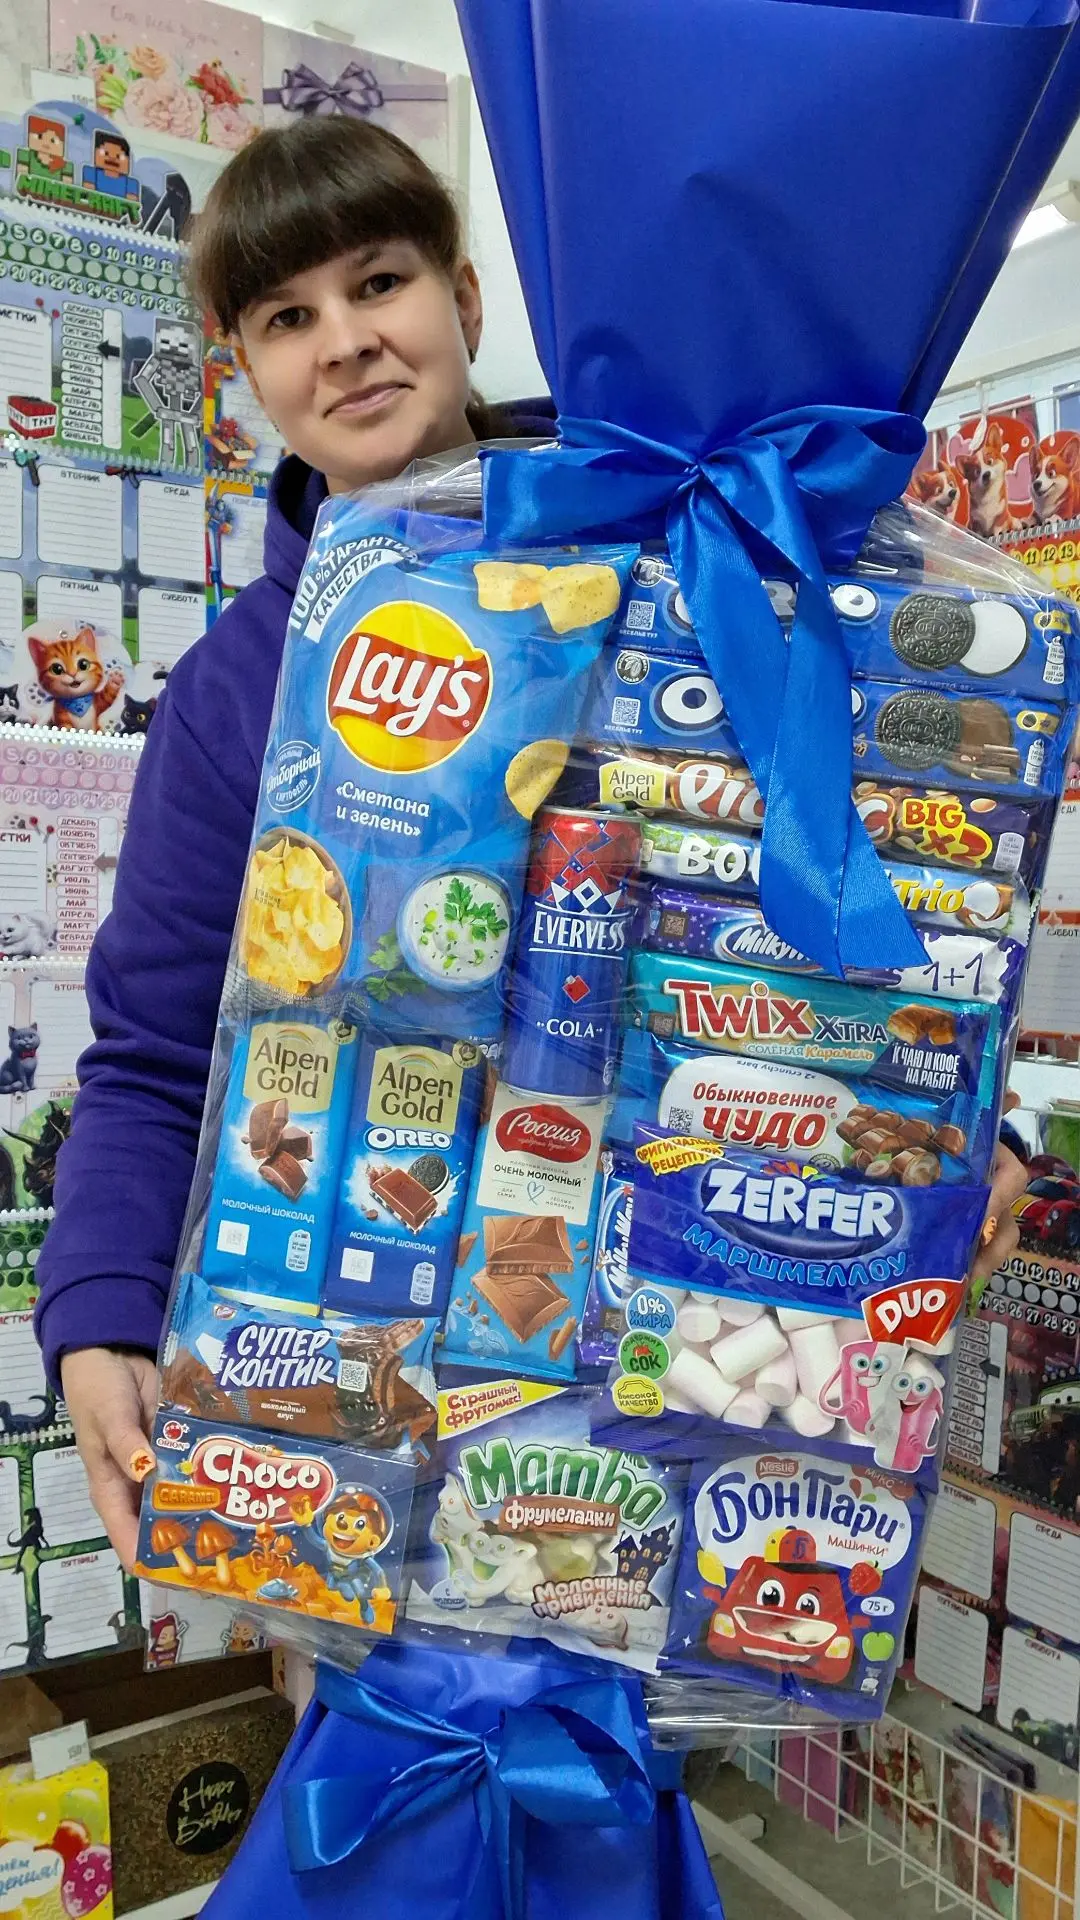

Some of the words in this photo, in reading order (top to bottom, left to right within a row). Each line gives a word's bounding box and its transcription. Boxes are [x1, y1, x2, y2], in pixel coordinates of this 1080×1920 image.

[13, 224, 26, 239] 5
[32, 229, 44, 244] 6
[50, 233, 63, 248] 7
[71, 238, 82, 252] 8
[89, 242, 100, 257] 9
[106, 246, 120, 261] 10
[125, 251, 138, 266] 11
[143, 255, 156, 270] 12
[161, 260, 174, 274] 13
[32, 416, 54, 427] TNT
[163, 485, 190, 497] СРЕДА
[1026, 550, 1038, 566] 11
[1043, 547, 1056, 562] 12
[1060, 543, 1074, 559] 13
[60, 580, 100, 592] ПЯТНИЦА
[312, 550, 383, 627] КАЧЕСТВА
[333, 635, 482, 737] Lay's
[267, 746, 321, 794] Отборный
[609, 768, 655, 787] Alpen
[335, 780, 430, 818] «Сметана
[612, 785, 650, 802] Gold
[335, 805, 347, 820] и
[350, 809, 421, 837] зелень»
[905, 800, 963, 829] BIG
[59, 864, 96, 874] АВГУСТ
[66, 898, 87, 908] МАЙ
[893, 878, 965, 914] Trio
[63, 922, 91, 931] МАРТ
[533, 910, 626, 952] EVERVESS
[922, 952, 984, 996] 1+1
[546, 1018, 595, 1038] COLA
[254, 1036, 329, 1074] Alpen
[736, 1059, 759, 1070] bars
[891, 1044, 900, 1065] К
[901, 1047, 923, 1069] ЧАЮ
[924, 1051, 933, 1070] И
[933, 1052, 960, 1074] КОФЕ
[256, 1066, 320, 1099] Gold
[377, 1061, 454, 1100] Alpen
[760, 1063, 802, 1077] crunchy
[905, 1069, 920, 1086] НА
[920, 1071, 957, 1091] РАБОТЕ
[380, 1091, 445, 1124] Gold
[692, 1081, 838, 1110] Обыкновенное
[367, 1127, 451, 1149] OREO
[506, 1112, 582, 1147] Россия
[702, 1105, 828, 1151] ЧУДО
[494, 1164, 525, 1177] ОЧЕНЬ
[526, 1168, 582, 1188] МОЛОЧНЫЙ
[221, 1198, 271, 1215] МОЛОЧНЫЙ
[271, 1206, 316, 1225] ШОКОЛАД
[705, 1168, 894, 1238] ZERFER
[349, 1230, 396, 1246] МОЛОЧНЫЙ
[396, 1237, 437, 1255] ШОКОЛАД
[682, 1223, 907, 1287] МАРШМЕЛЛОУ
[1013, 1259, 1025, 1276] 11
[1031, 1265, 1042, 1280] 12
[1048, 1269, 1061, 1286] 13
[1066, 1274, 1080, 1292] 14
[637, 1294, 666, 1315] 0%
[875, 1288, 947, 1334] DUO
[992, 1298, 1006, 1314] 25
[1009, 1302, 1023, 1319] 26
[1026, 1307, 1040, 1323] 27
[1043, 1313, 1058, 1330] 28
[1061, 1319, 1076, 1335] 29
[629, 1309, 672, 1329] ЖИРА
[236, 1325, 331, 1358] СУПЕР
[622, 1333, 662, 1352] СОДЕРЖИТ
[219, 1355, 335, 1389] КОНТИК
[629, 1354, 662, 1373] СОК
[260, 1402, 306, 1414] шоколадный
[447, 1383, 518, 1411] Страшный
[617, 1391, 658, 1401] ВЫСОКОЕ
[619, 1398, 659, 1408] КАЧЕСТВО
[276, 1411, 294, 1421] вкус
[157, 1437, 187, 1451] ORION
[202, 1445, 322, 1489] Choco
[462, 1440, 664, 1527] Mamba
[534, 1577, 648, 1601] Молочные
[532, 1591, 651, 1619] привидения
[867, 1600, 881, 1612] 75
